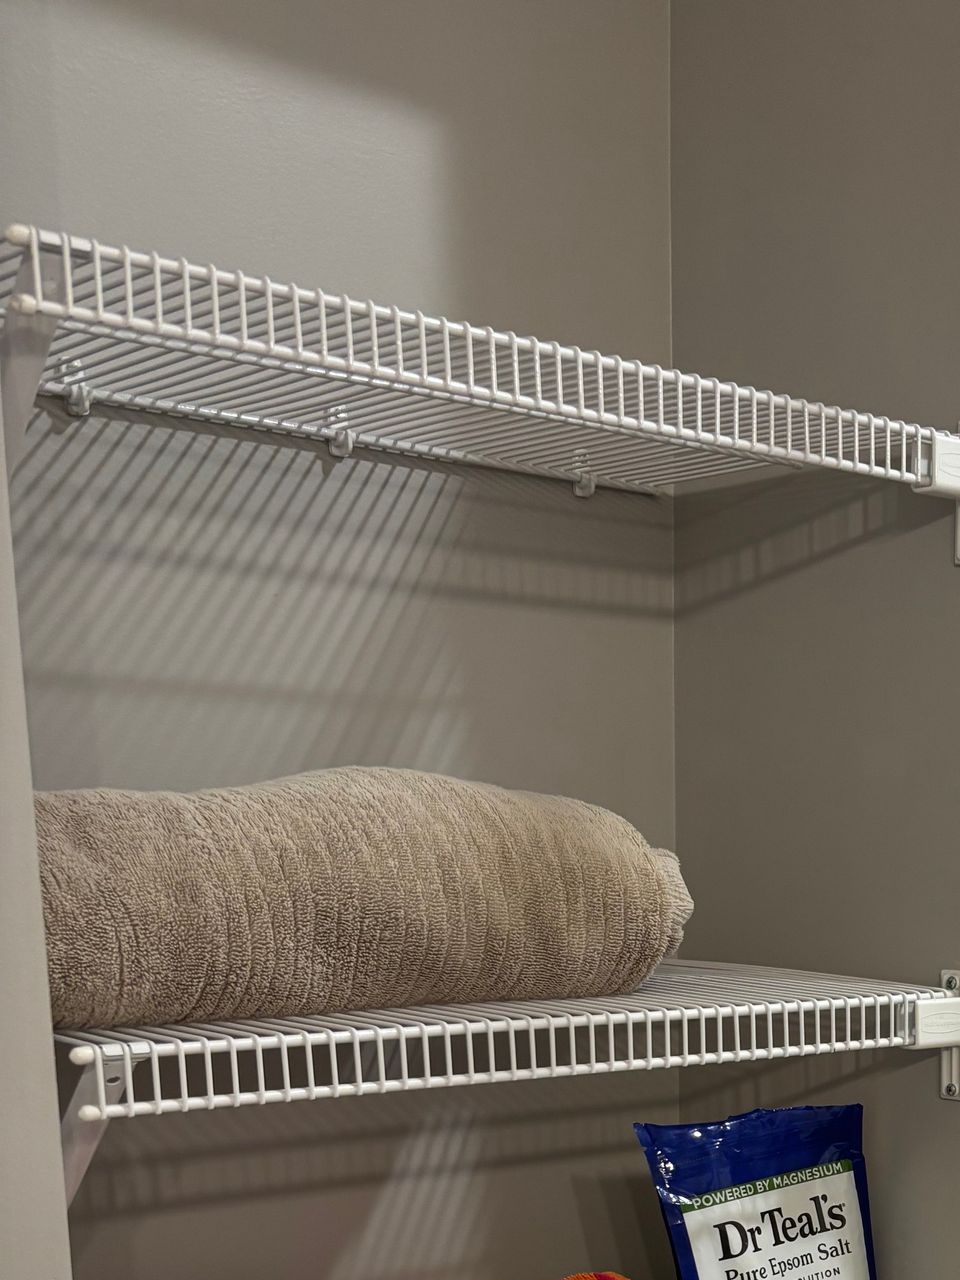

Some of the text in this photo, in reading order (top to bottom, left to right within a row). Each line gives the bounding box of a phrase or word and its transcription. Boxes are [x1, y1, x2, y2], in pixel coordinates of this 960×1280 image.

[692, 1162, 843, 1209] POWERED BY MAGNESIUM
[760, 1194, 847, 1247] Teal's
[769, 1251, 814, 1277] Epsom
[817, 1238, 852, 1261] Salt
